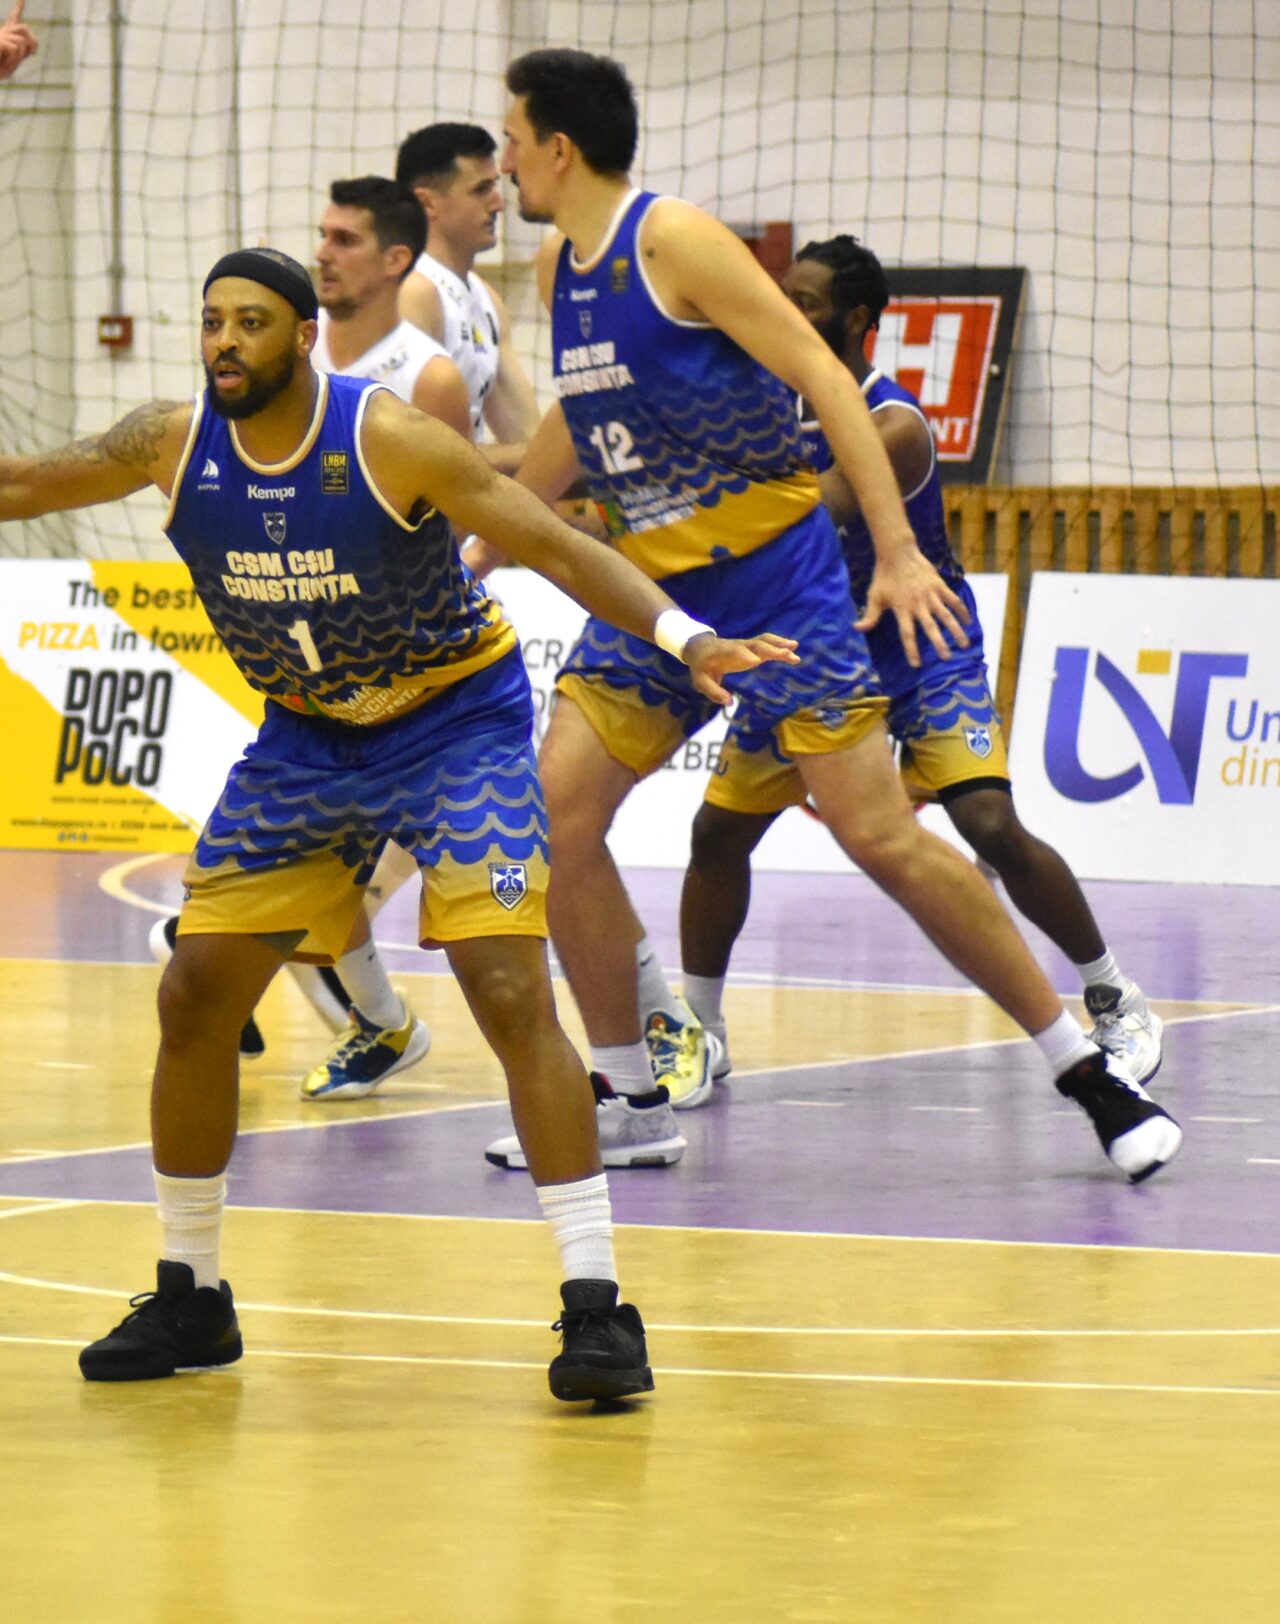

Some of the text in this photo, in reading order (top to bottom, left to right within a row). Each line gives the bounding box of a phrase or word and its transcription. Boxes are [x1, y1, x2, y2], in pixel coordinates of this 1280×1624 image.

[588, 420, 645, 476] 12
[247, 484, 295, 501] Kempa
[226, 548, 335, 577] CSM CSU
[68, 580, 198, 609] The best
[18, 621, 100, 650] PIZZA
[111, 624, 138, 650] in
[287, 619, 323, 672] 1
[64, 667, 174, 739] DOPO
[1220, 745, 1280, 787] din
